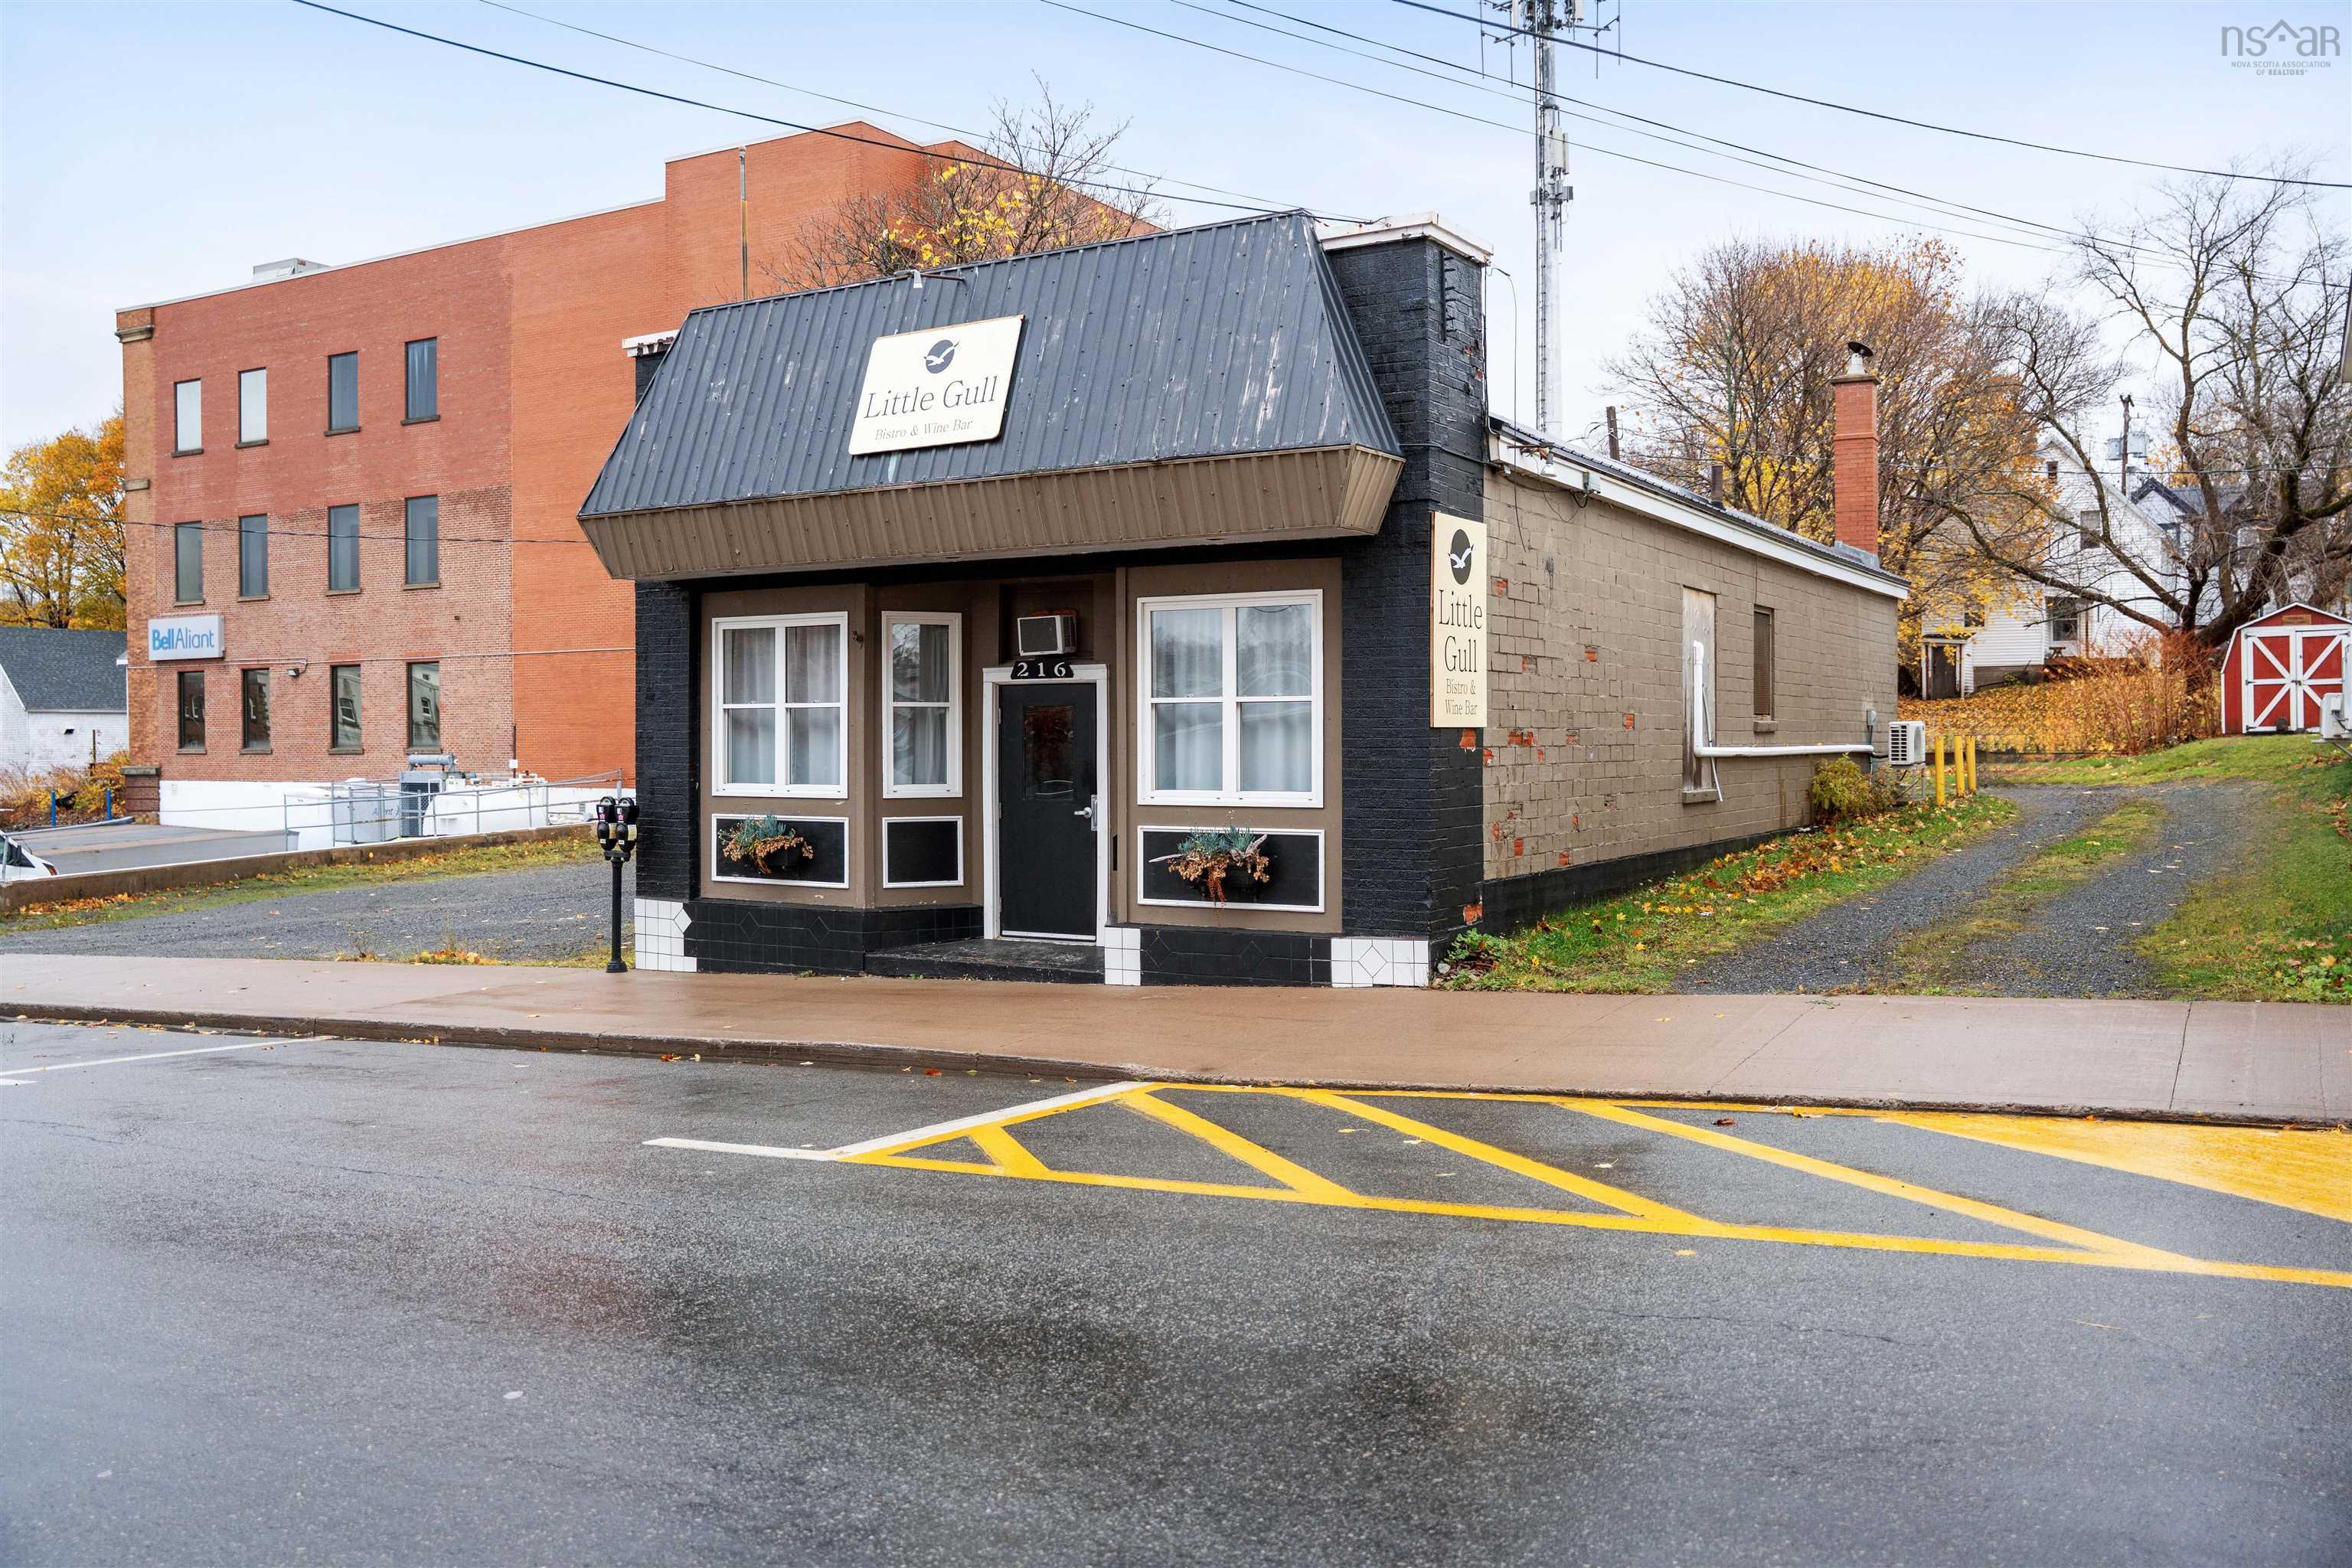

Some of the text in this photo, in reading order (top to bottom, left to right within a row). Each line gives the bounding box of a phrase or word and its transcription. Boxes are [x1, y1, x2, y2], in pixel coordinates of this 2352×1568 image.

[863, 375, 998, 419] Little Gull
[874, 419, 973, 441] Bistro & Wine Bar
[1438, 589, 1483, 629] Little
[1444, 635, 1478, 673] Gull
[1017, 662, 1067, 678] 216
[1446, 678, 1476, 695] Bistro &
[1445, 699, 1478, 715] Wine Bar
